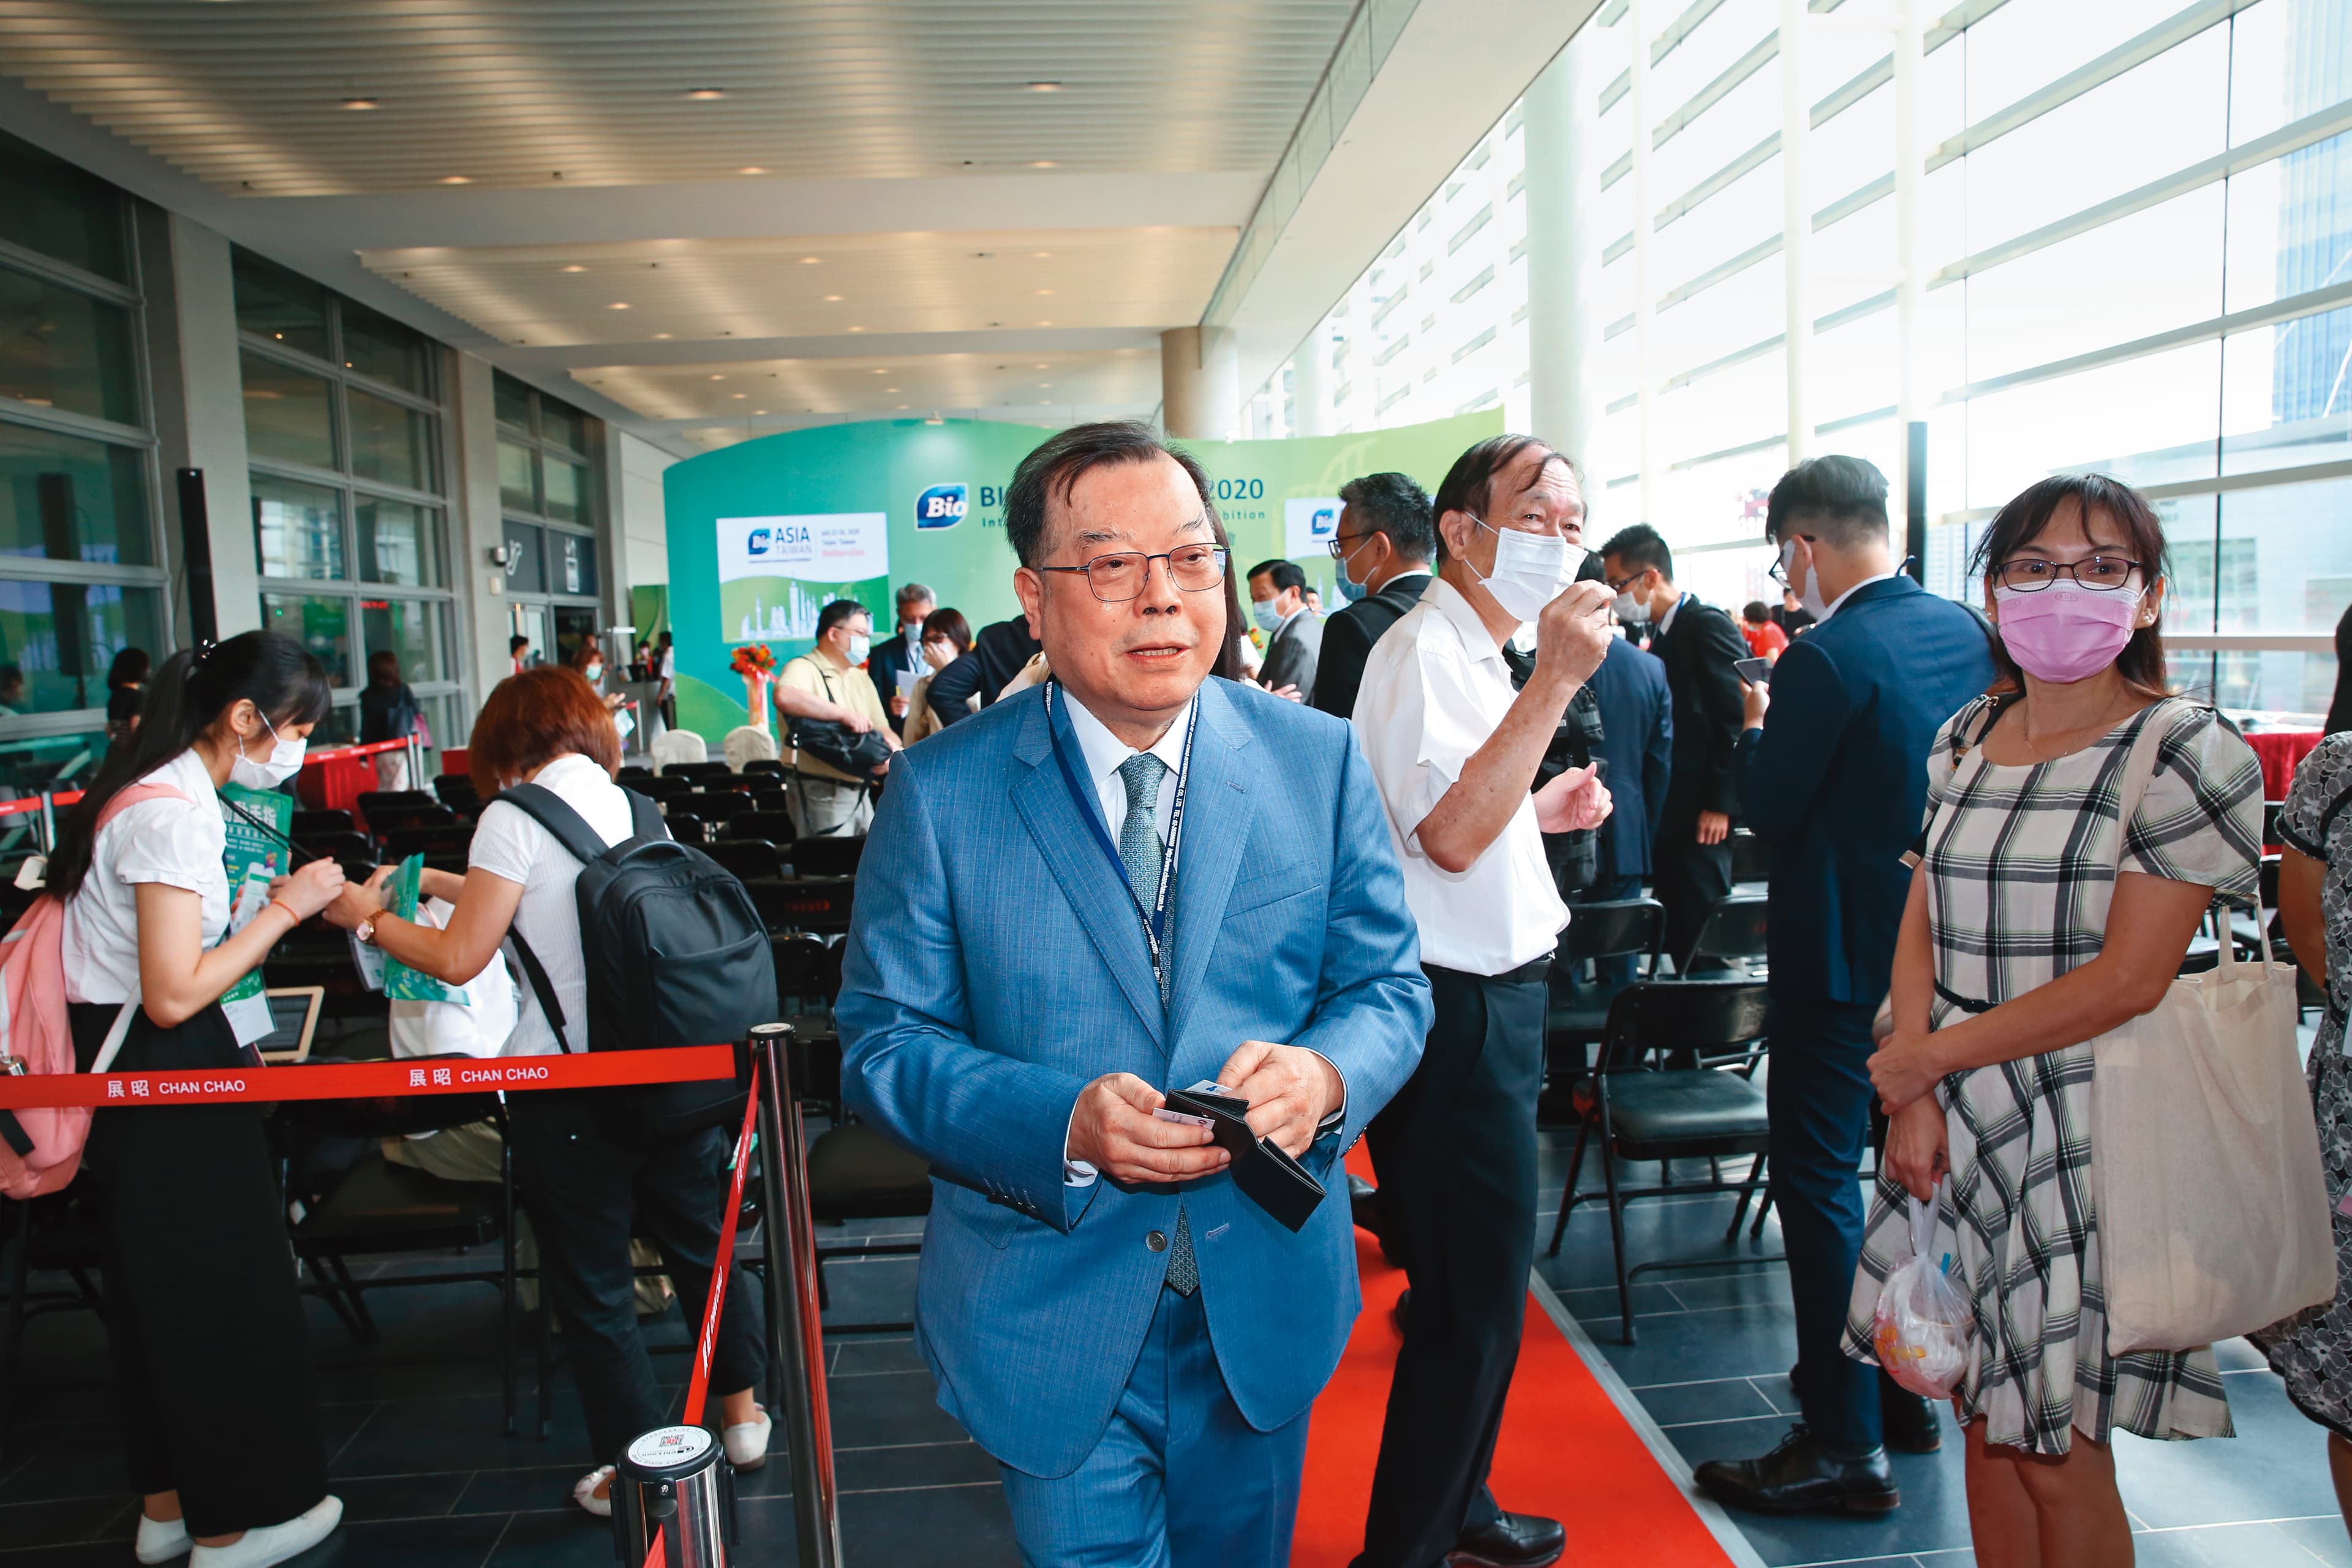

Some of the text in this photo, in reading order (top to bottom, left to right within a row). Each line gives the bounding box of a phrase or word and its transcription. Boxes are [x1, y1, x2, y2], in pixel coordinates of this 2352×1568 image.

[981, 487, 1003, 507] BI
[926, 496, 967, 518] Bio
[1223, 510, 1265, 520] bition
[775, 527, 810, 543] ASIA
[775, 544, 812, 554] TAIWAN
[1178, 756, 1189, 788] INTERNATIONAL
[409, 1067, 549, 1087] 展昭 CHAN CHAO
[107, 1080, 246, 1098] 展昭 CHAN CHAO
